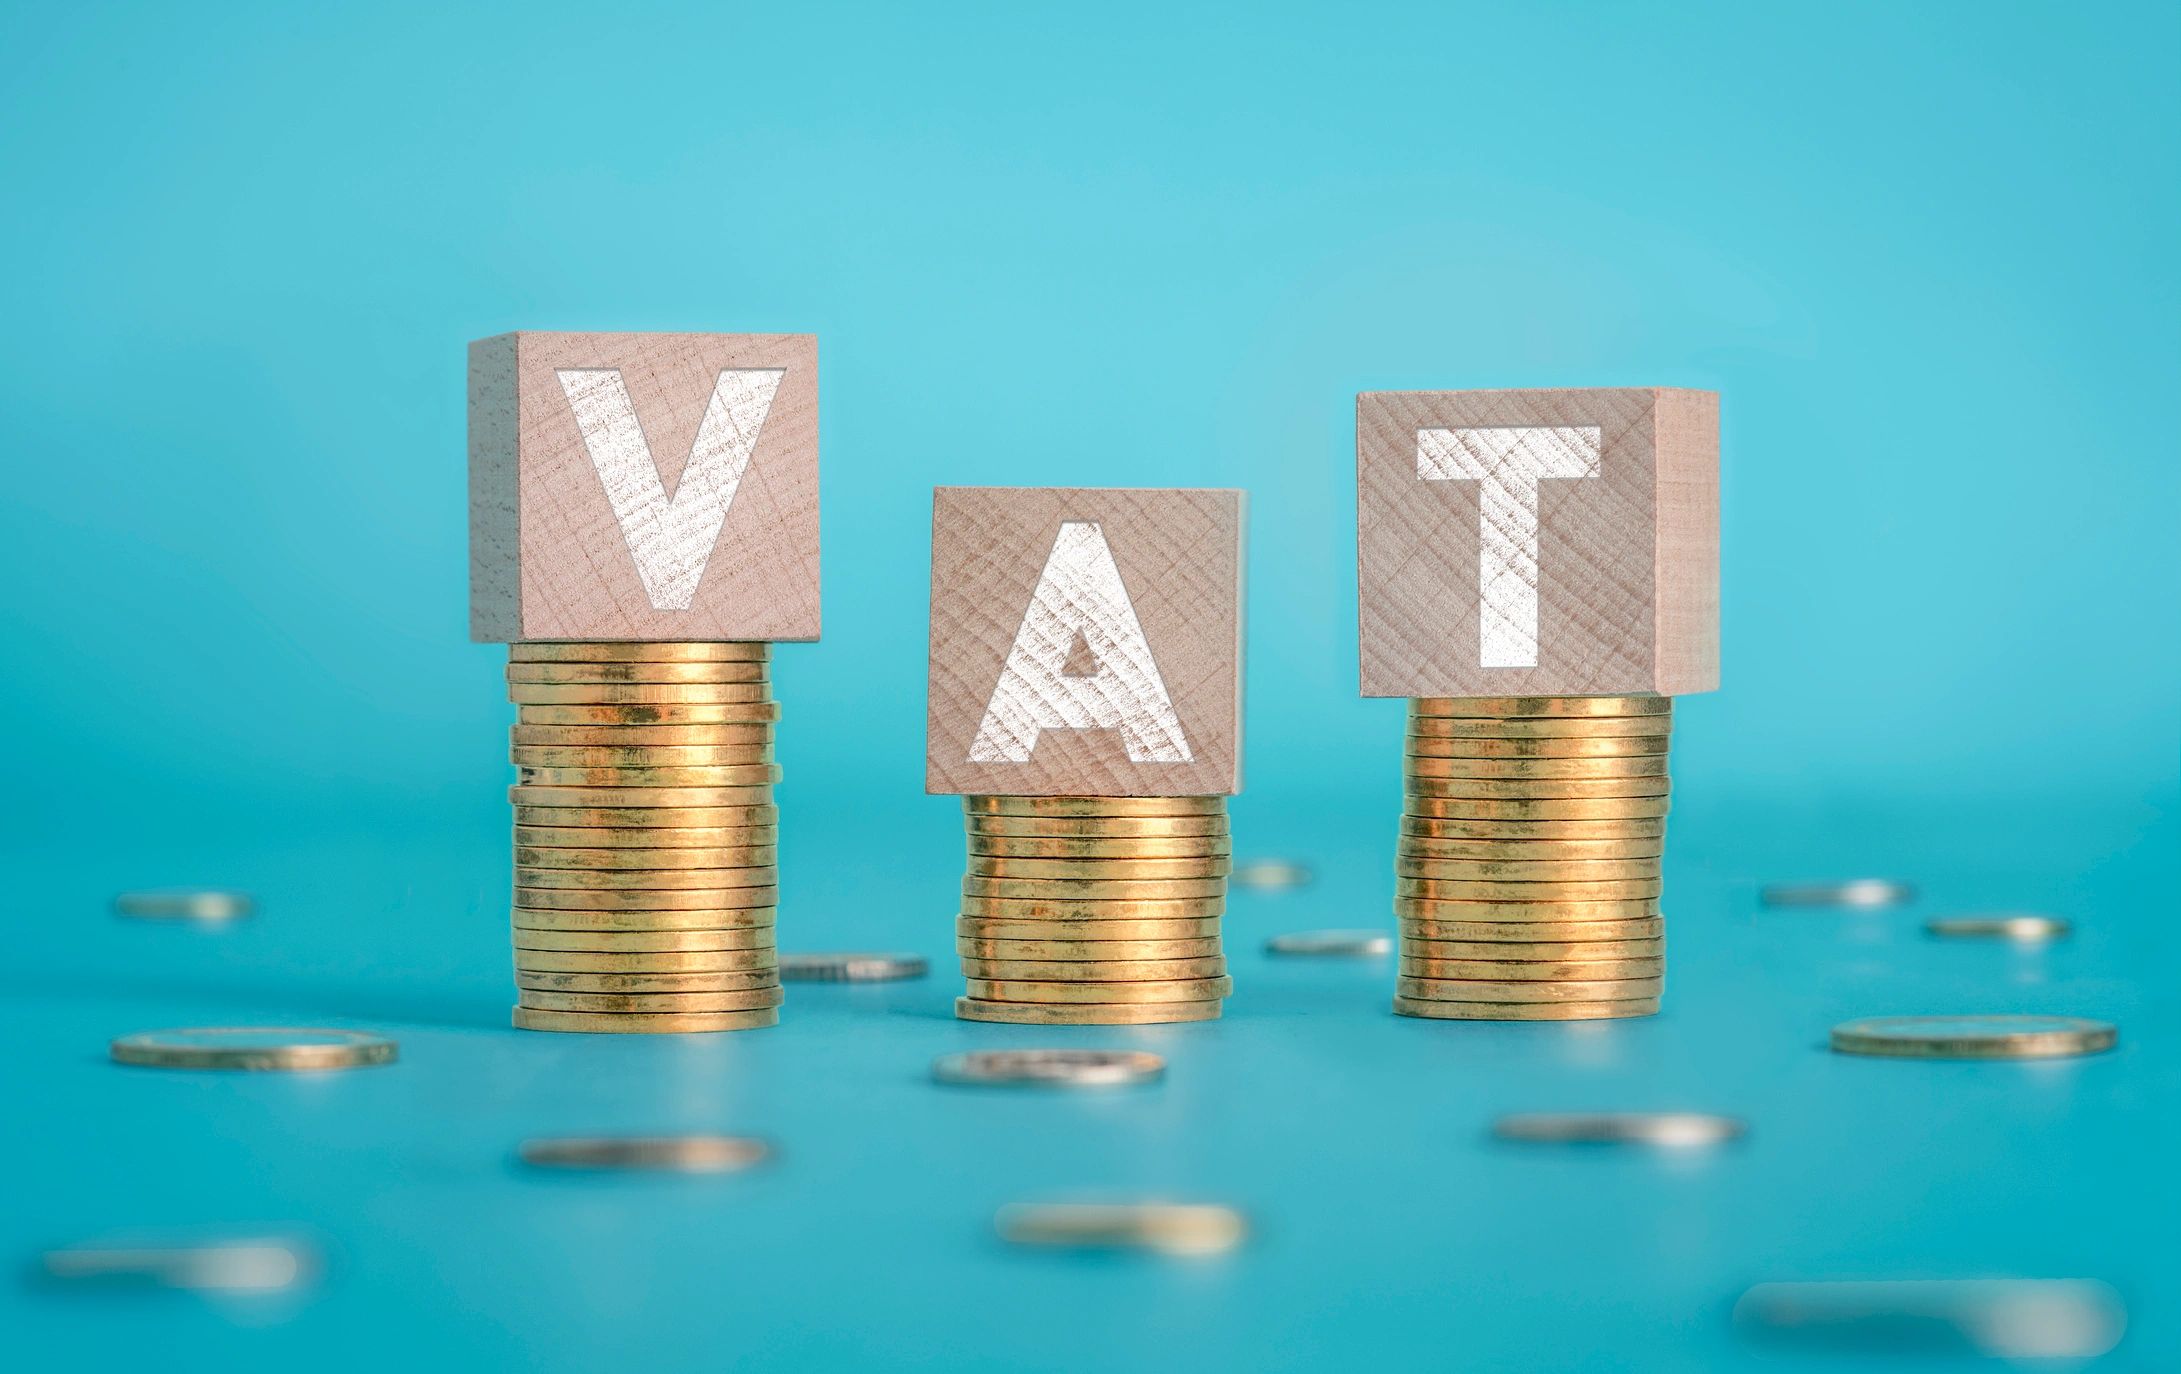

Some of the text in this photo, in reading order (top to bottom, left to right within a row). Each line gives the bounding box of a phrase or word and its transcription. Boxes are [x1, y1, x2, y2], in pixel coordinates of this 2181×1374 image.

[554, 367, 787, 611] V
[1416, 426, 1602, 669] T
[967, 520, 1195, 763] A
